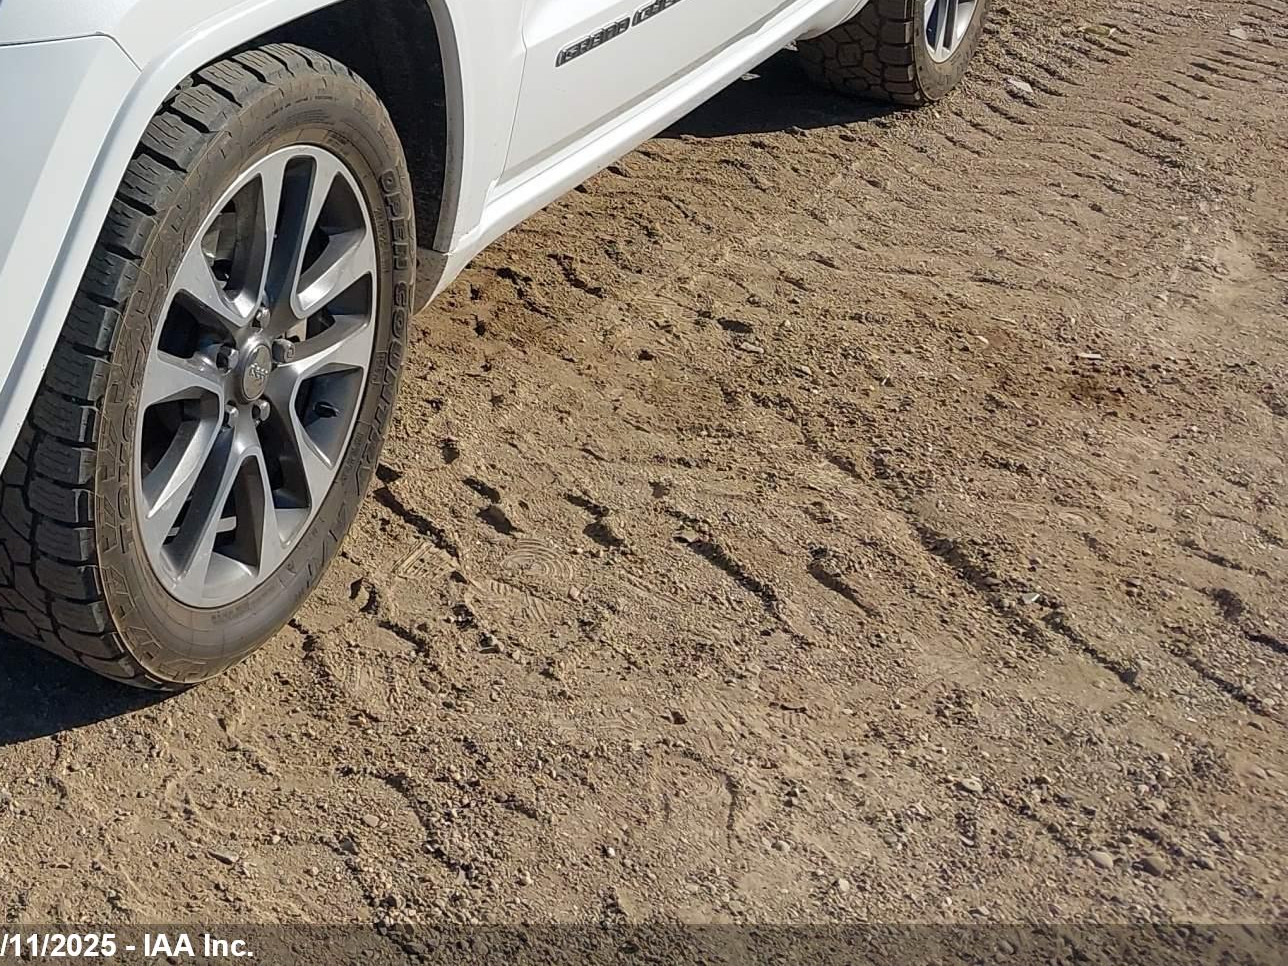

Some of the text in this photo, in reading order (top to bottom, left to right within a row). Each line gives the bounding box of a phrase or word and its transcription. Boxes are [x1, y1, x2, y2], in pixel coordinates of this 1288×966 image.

[555, 16, 631, 68] GRAND
[379, 168, 409, 272] OPEN
[355, 281, 409, 498] COUNTRY
